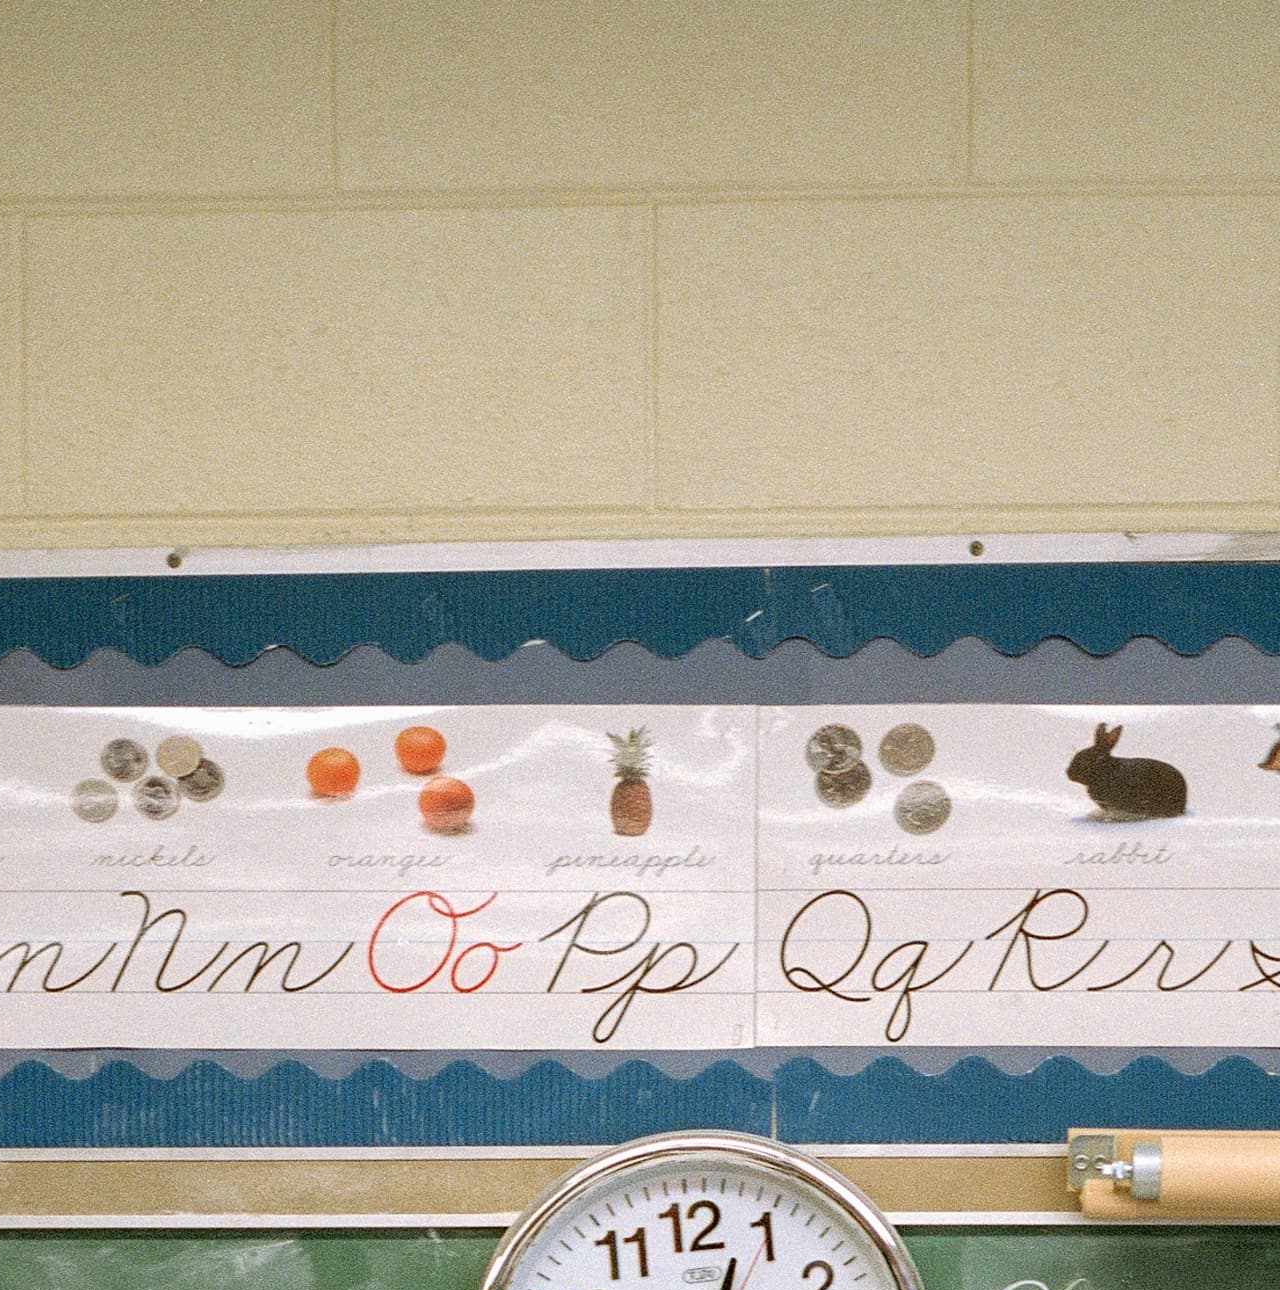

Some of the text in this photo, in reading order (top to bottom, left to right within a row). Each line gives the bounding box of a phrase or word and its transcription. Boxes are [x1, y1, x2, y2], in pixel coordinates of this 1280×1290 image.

[90, 845, 219, 869] nickels
[328, 853, 455, 878] oranges
[545, 845, 719, 877] pineapple
[808, 847, 952, 875] quarters
[1062, 840, 1176, 865] rabbit
[658, 1199, 726, 1254] 12
[750, 1211, 777, 1262] 1
[594, 1226, 649, 1281] 11
